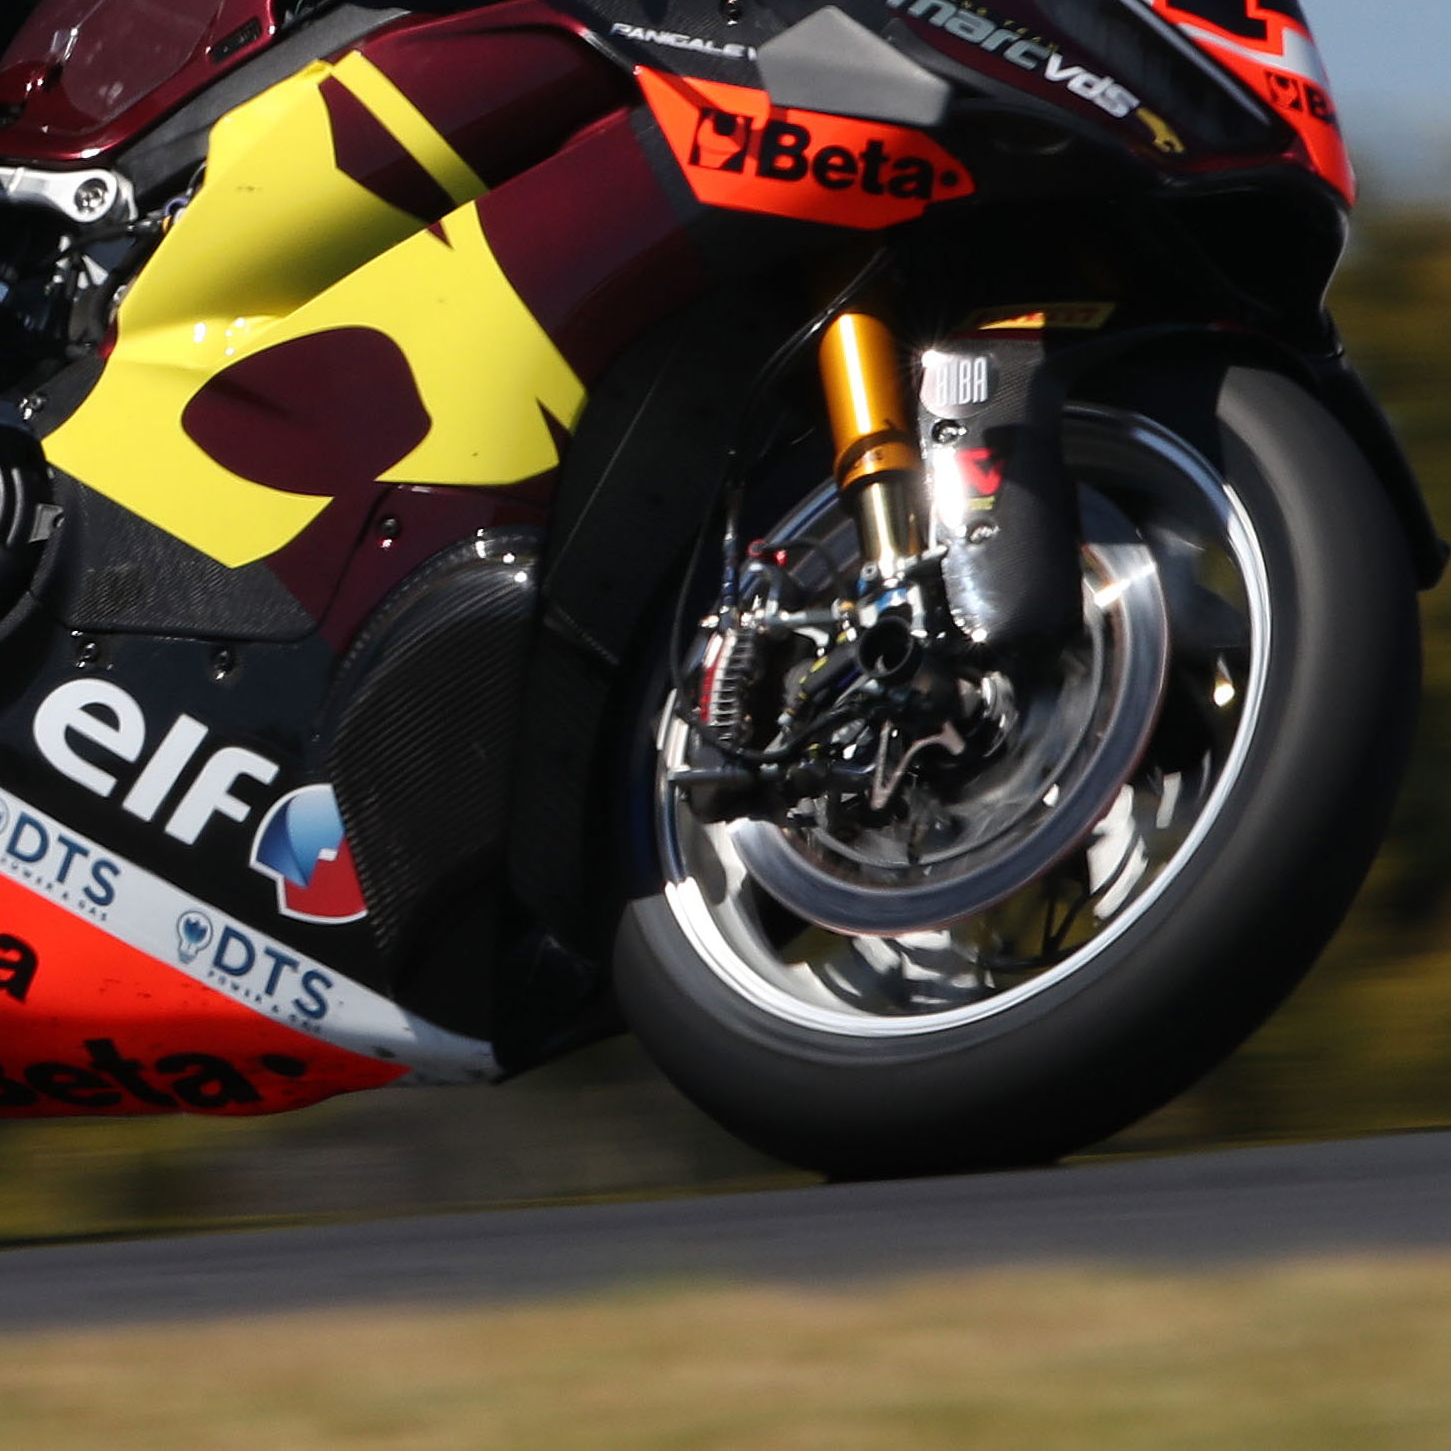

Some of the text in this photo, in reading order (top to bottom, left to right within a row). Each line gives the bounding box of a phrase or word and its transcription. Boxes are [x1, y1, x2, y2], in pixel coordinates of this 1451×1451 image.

[755, 119, 935, 201] Beta
[33, 678, 280, 846] elf
[6, 811, 121, 907] DTS
[213, 925, 334, 1020] DTS
